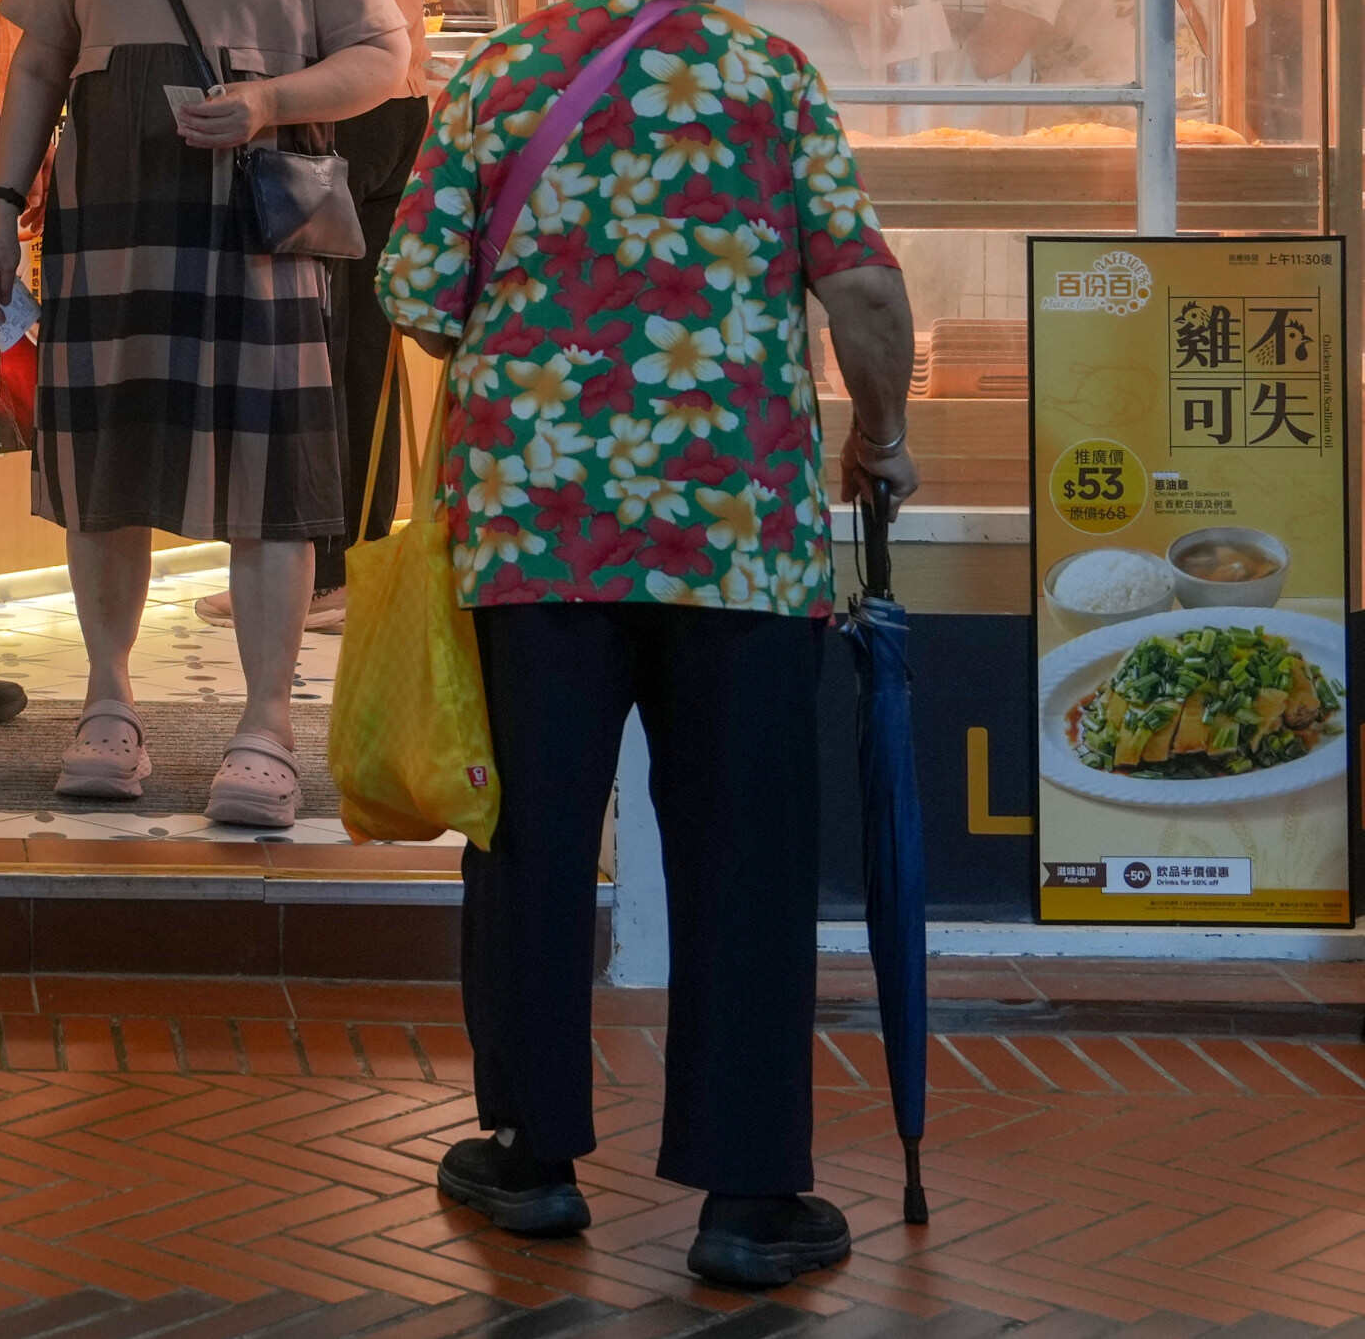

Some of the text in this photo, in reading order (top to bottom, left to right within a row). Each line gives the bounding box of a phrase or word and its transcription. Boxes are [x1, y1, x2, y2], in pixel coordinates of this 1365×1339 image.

[1057, 273, 1133, 298] 百份百
[1075, 448, 1124, 466] 推廣價
[1064, 467, 1125, 501] $53
[1157, 866, 1229, 878] 飲品半價優惠
[1157, 878, 1179, 886] Drinks
